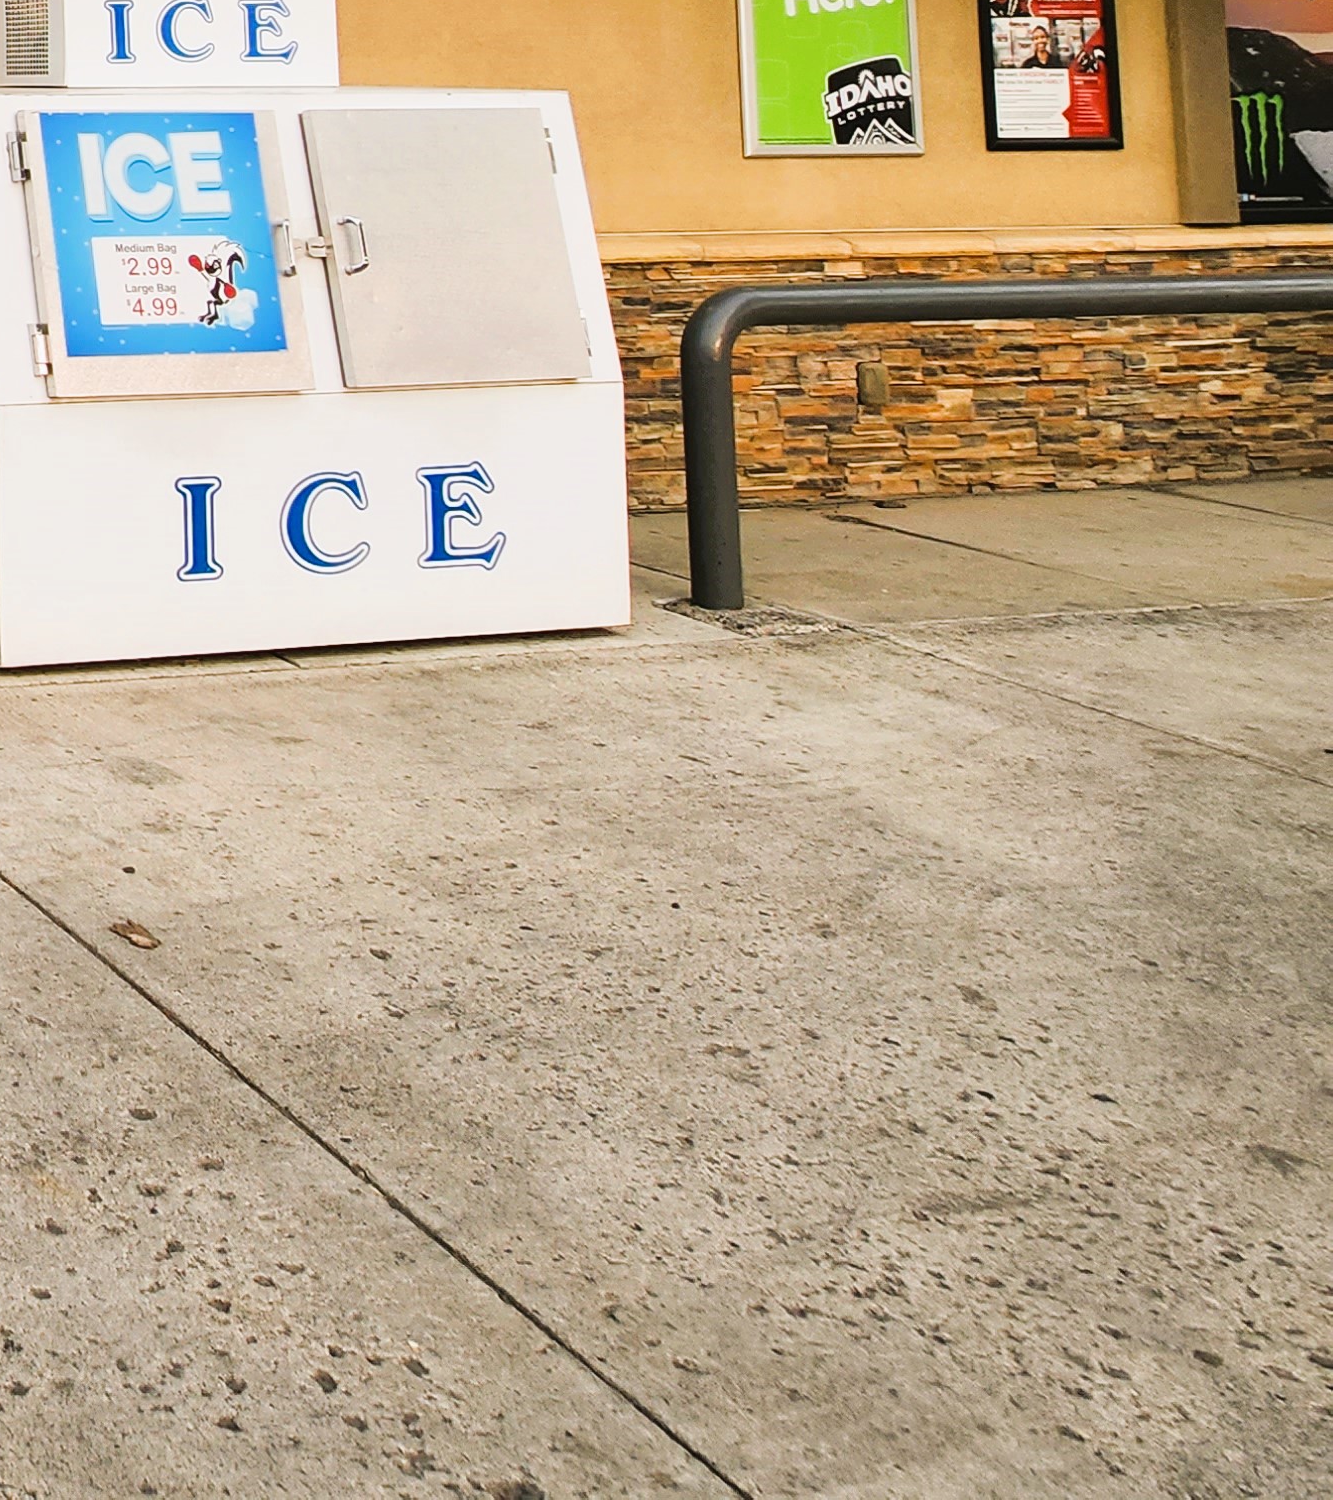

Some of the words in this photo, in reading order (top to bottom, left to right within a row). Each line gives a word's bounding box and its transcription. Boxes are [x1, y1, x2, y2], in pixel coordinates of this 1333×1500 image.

[825, 73, 913, 118] IDAHO
[837, 100, 906, 126] LOTTERY
[76, 130, 231, 221] ICE
[115, 243, 155, 253] Medium
[157, 243, 177, 254] Bag
[125, 283, 154, 295] Large
[157, 283, 177, 294] Bag
[175, 461, 506, 582] ICE
